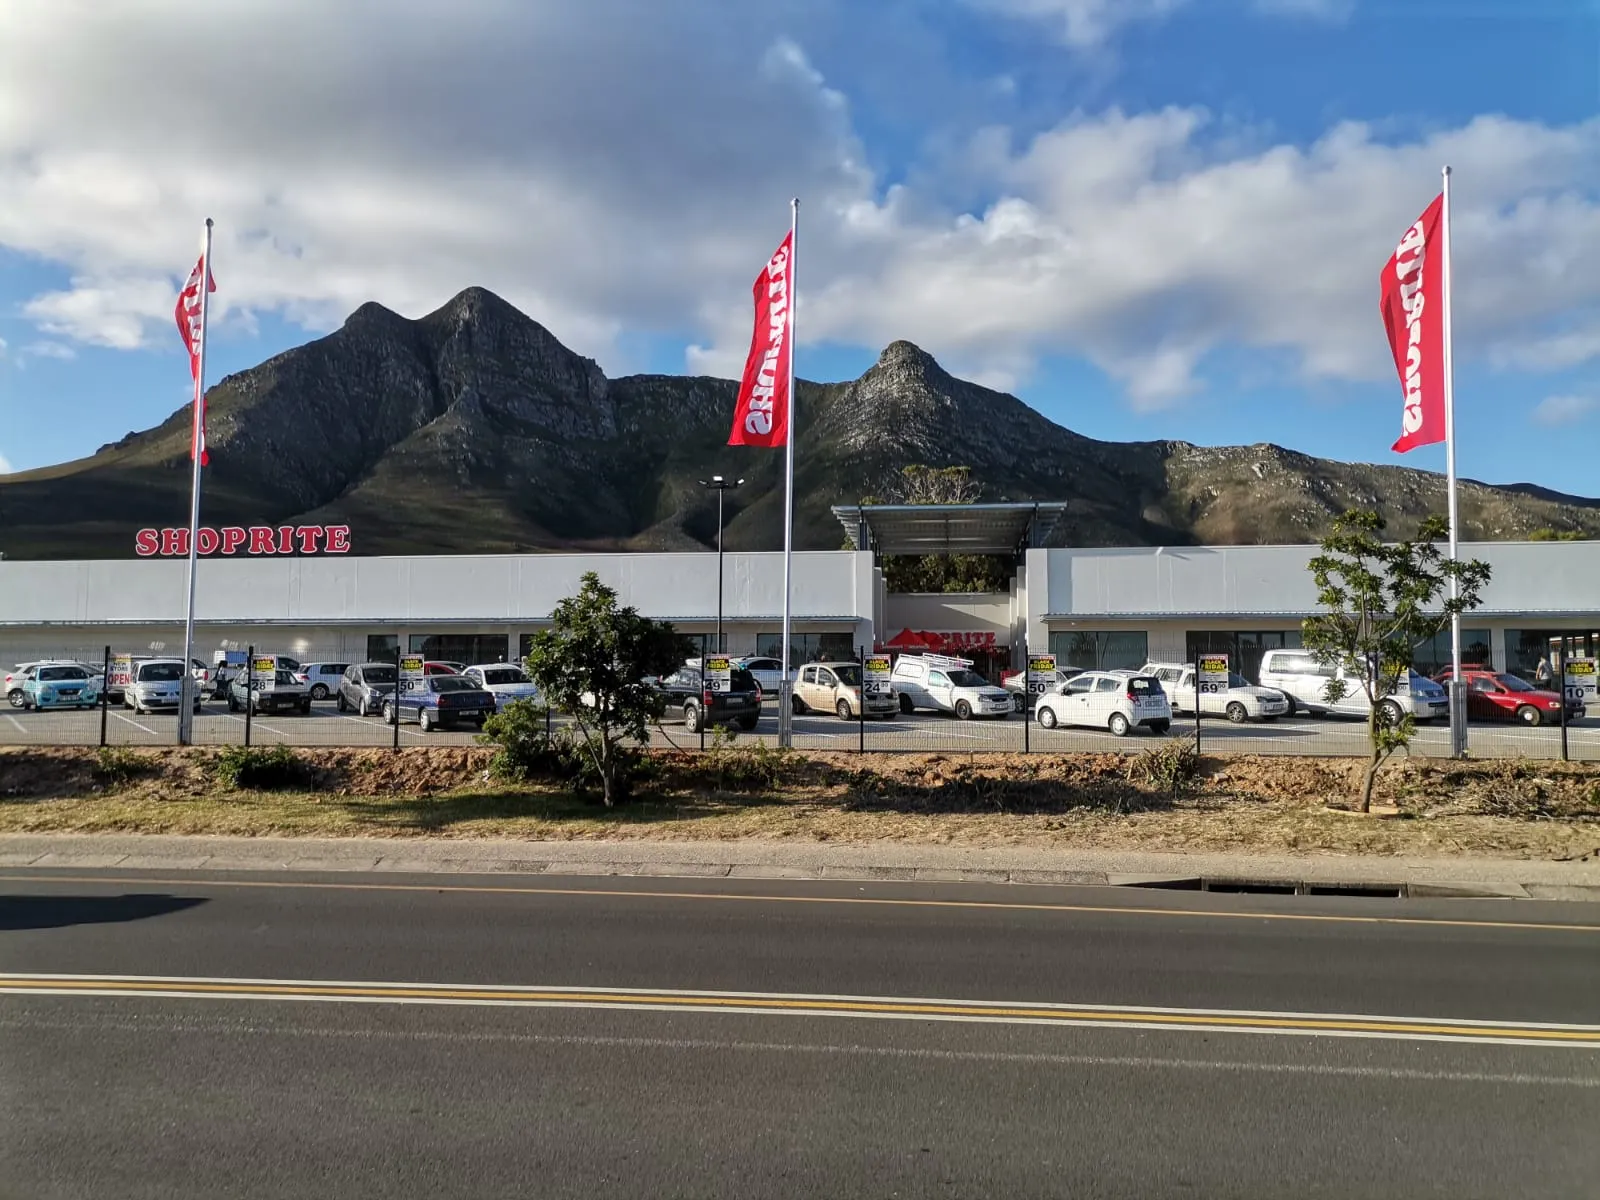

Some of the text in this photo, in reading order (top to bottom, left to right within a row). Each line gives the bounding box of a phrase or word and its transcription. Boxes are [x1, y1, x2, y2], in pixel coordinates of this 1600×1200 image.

[135, 525, 351, 556] SHOPRITE
[939, 632, 996, 645] PRITE
[108, 673, 130, 685] OPEN
[400, 681, 414, 691] 50
[704, 681, 720, 691] 49
[864, 682, 880, 693] 24
[1029, 683, 1045, 693] 50
[1201, 683, 1218, 694] 69
[1566, 687, 1584, 698] 10
